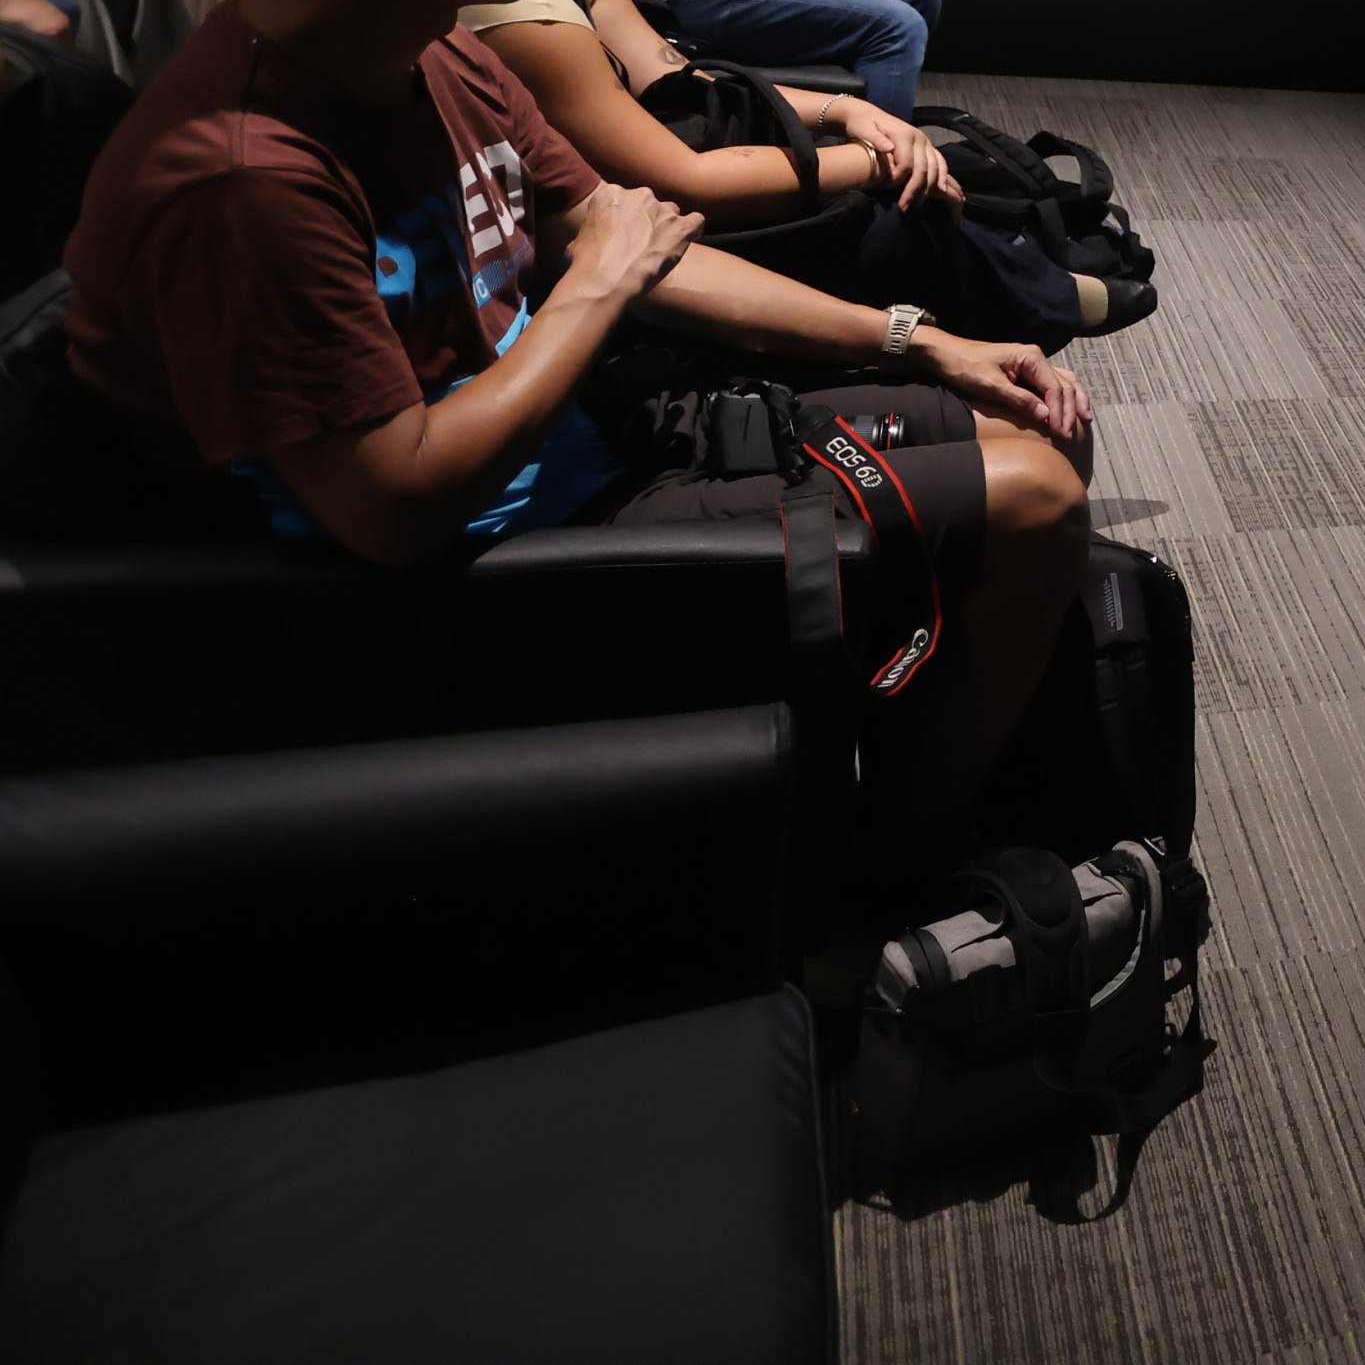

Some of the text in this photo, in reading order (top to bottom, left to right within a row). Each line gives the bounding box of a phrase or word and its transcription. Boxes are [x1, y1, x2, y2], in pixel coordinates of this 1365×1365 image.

[826, 436, 883, 488] EOS 6D
[877, 628, 929, 688] Canon
